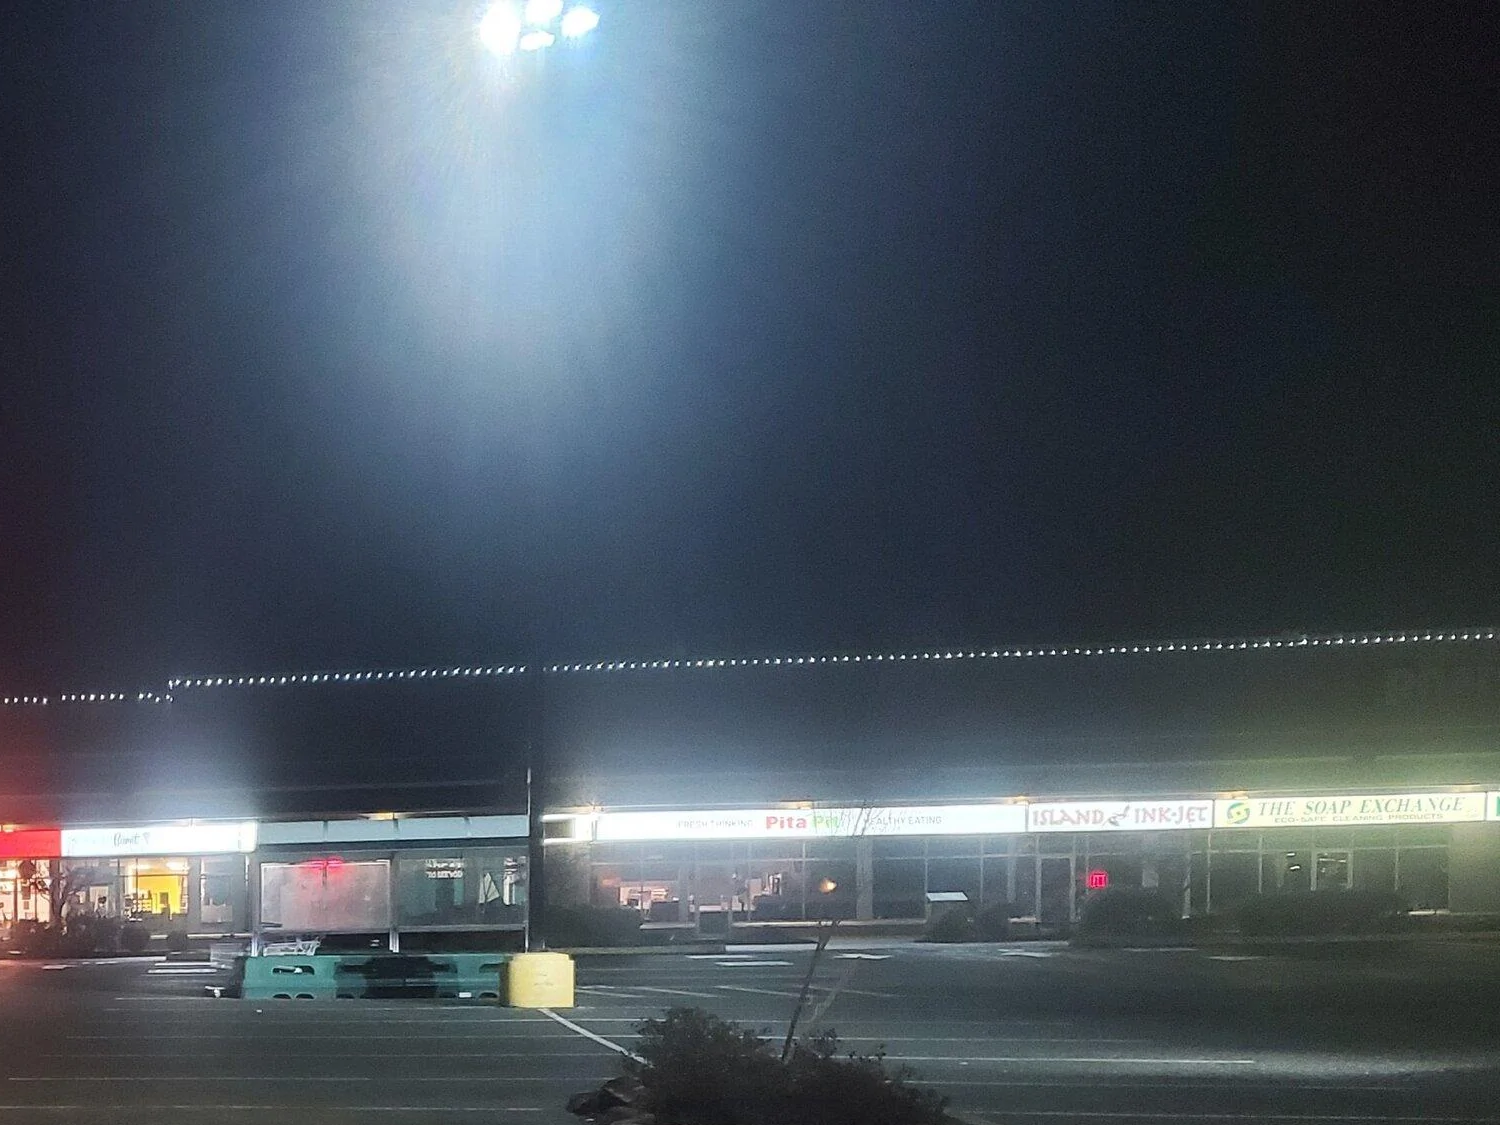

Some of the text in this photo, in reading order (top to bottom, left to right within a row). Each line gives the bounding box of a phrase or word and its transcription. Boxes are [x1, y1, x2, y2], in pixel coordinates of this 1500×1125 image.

[1259, 797, 1466, 815] THE SOAP EXCHANGE
[766, 816, 807, 829] Pita
[908, 815, 943, 825] EATING
[1033, 809, 1105, 825] ISLAND
